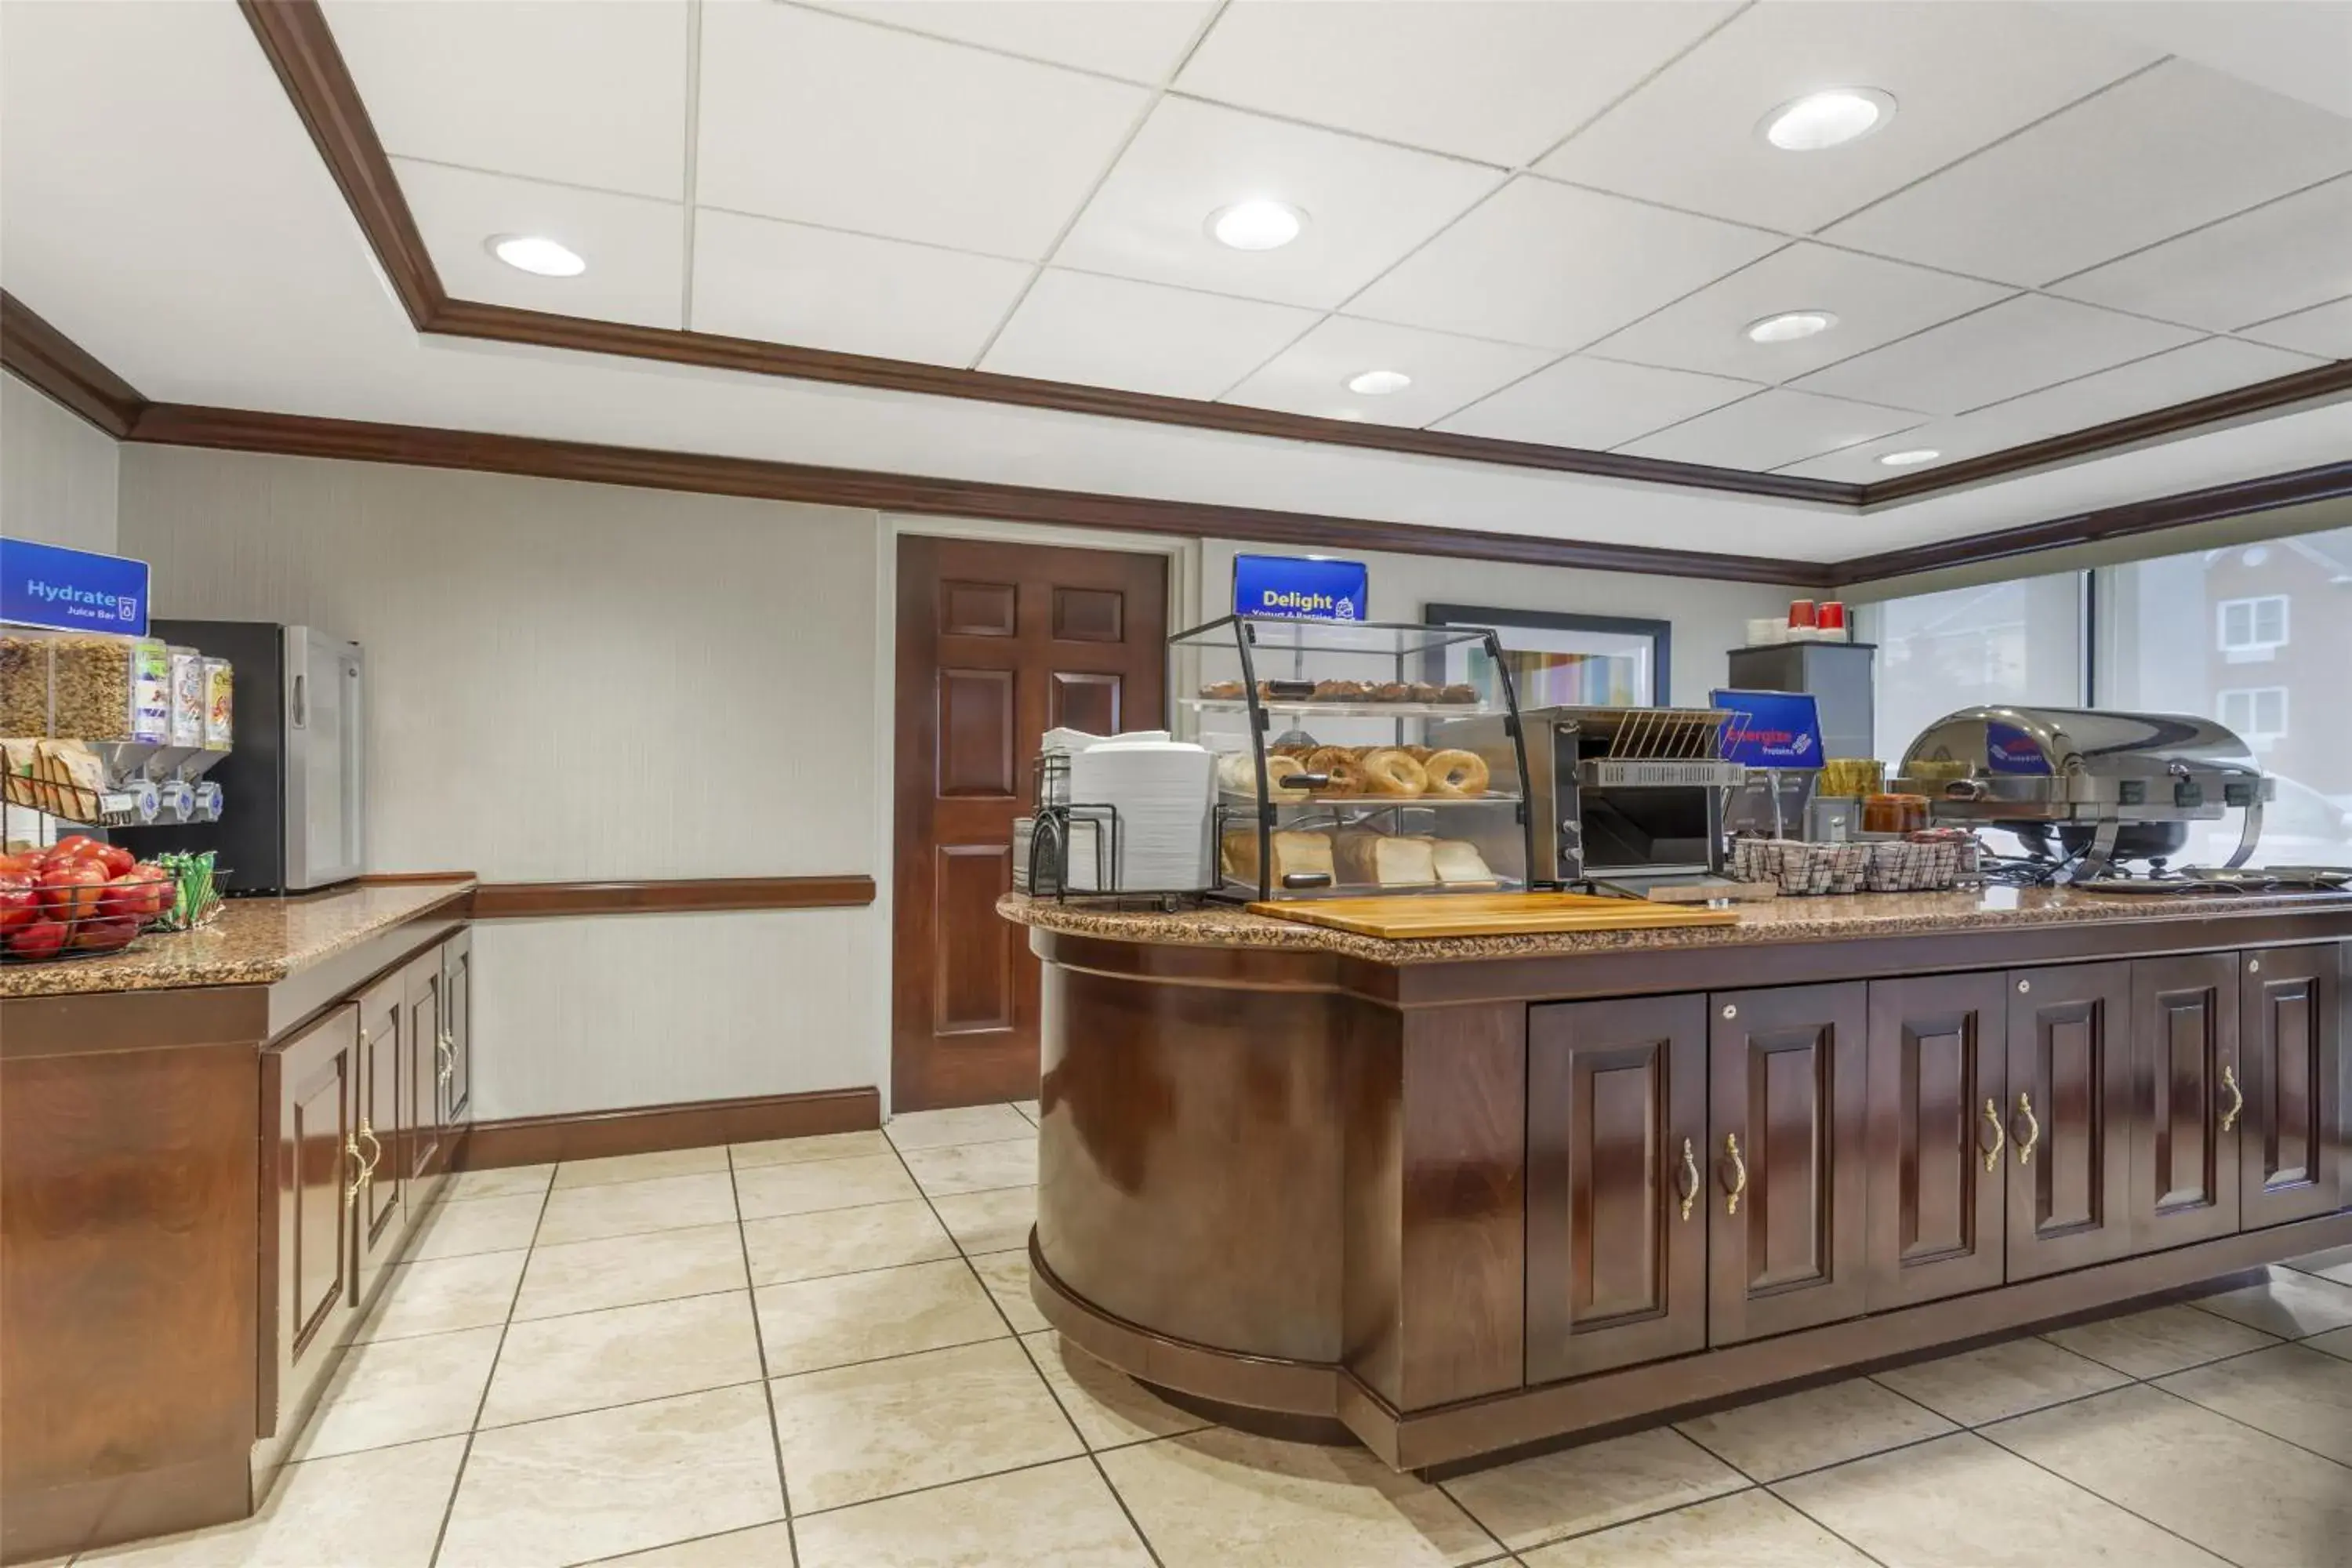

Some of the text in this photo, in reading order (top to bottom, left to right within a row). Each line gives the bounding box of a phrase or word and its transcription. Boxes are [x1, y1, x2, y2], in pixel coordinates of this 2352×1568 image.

[27, 579, 117, 607] Hydrate
[1263, 590, 1333, 612] Delight
[67, 606, 116, 620] Juice Bar
